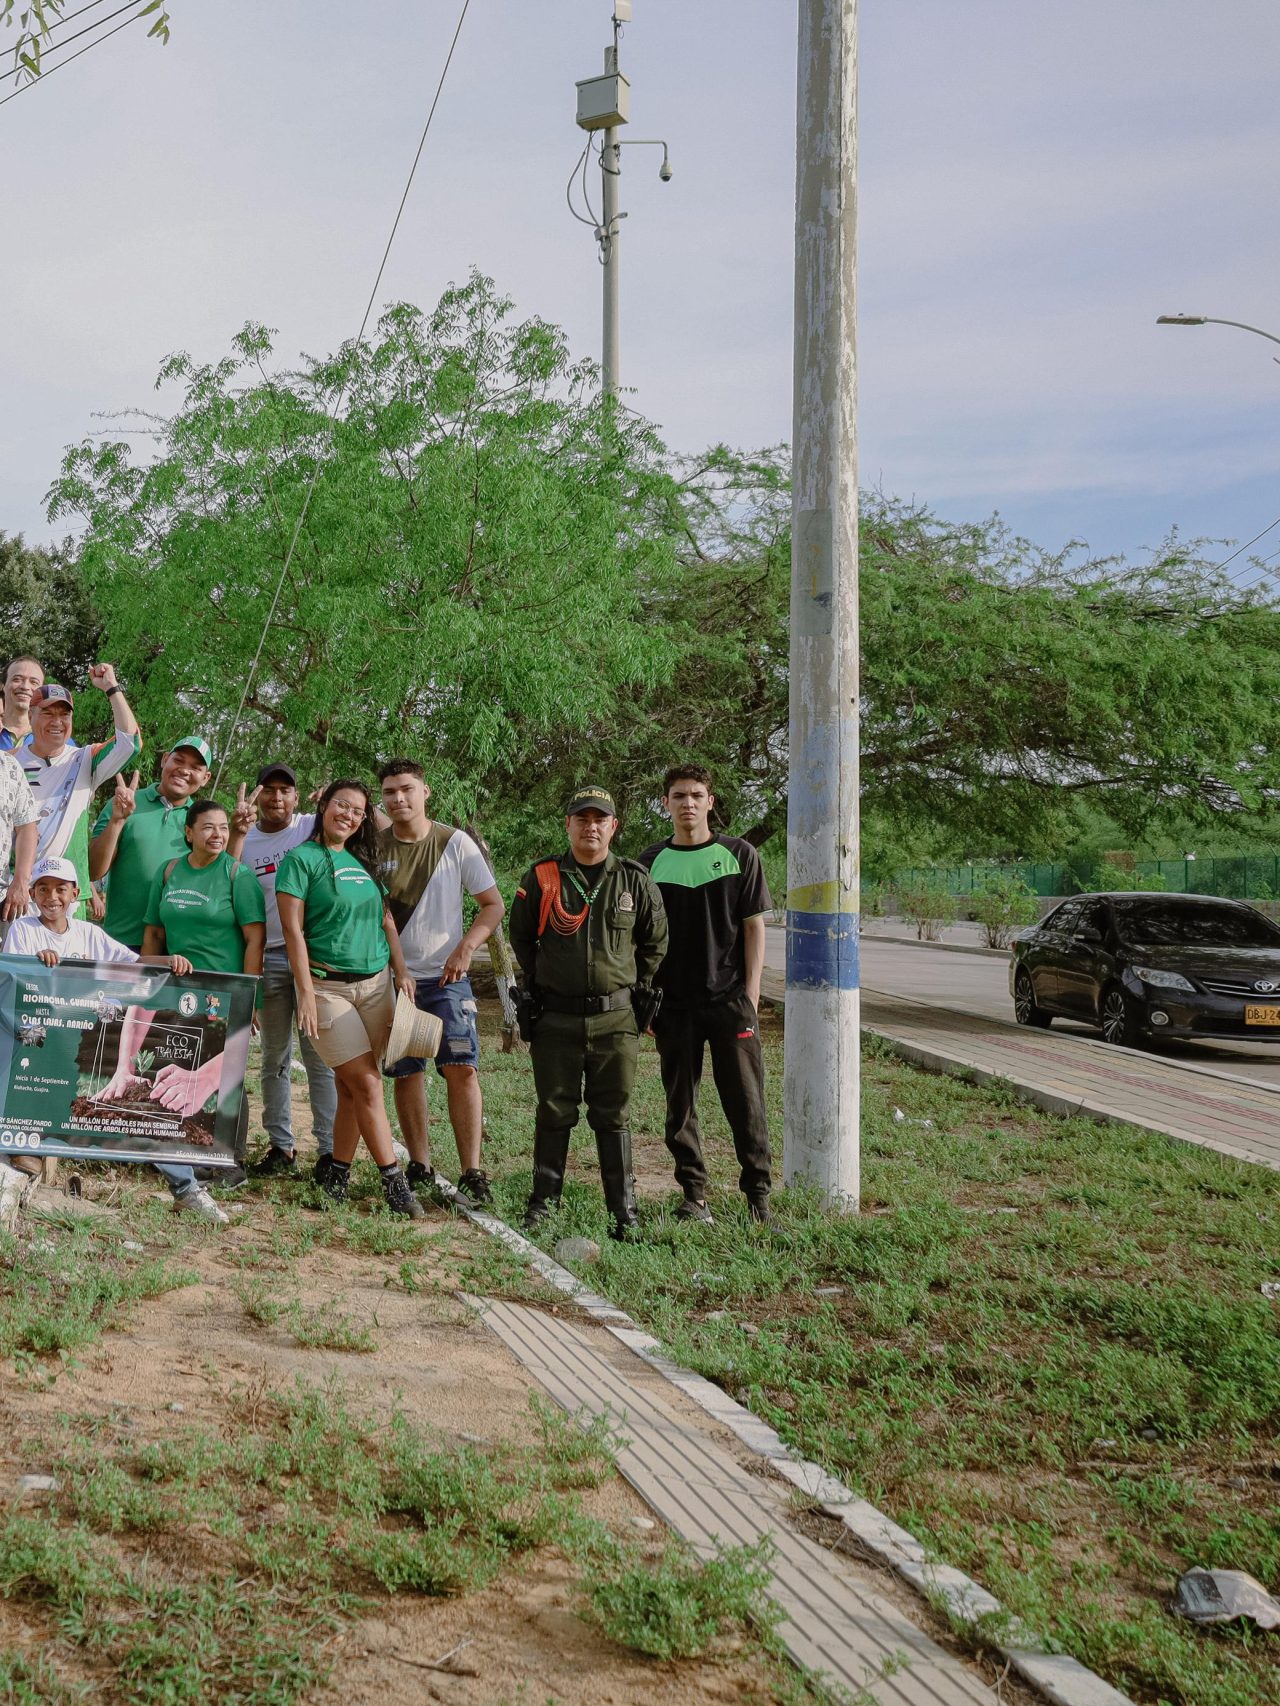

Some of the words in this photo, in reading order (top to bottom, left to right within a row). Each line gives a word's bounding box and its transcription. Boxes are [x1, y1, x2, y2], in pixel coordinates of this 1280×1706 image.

[574, 789, 611, 802] POLICIA
[36, 1008, 49, 1016] HASTA
[28, 1016, 41, 1026] LAS
[67, 1020, 94, 1030] NARIÑO
[166, 1034, 189, 1048] ECO
[41, 1076, 70, 1086] Septiembre
[6, 1116, 33, 1126] SÁNCHEZ
[33, 1120, 52, 1128] PARDO
[69, 1115, 79, 1123] UN
[79, 1116, 101, 1125] MILLÓN
[101, 1118, 110, 1126] DE
[136, 1120, 152, 1129] PARA
[152, 1121, 179, 1131] SEMBRAR
[60, 1121, 70, 1130] UN
[70, 1122, 94, 1131] MILLÓN
[93, 1124, 102, 1132] DE
[102, 1125, 130, 1134] ARBOLES
[129, 1127, 145, 1136] PARA
[144, 1128, 153, 1136] LA
[152, 1129, 187, 1138] HUMANIDAD
